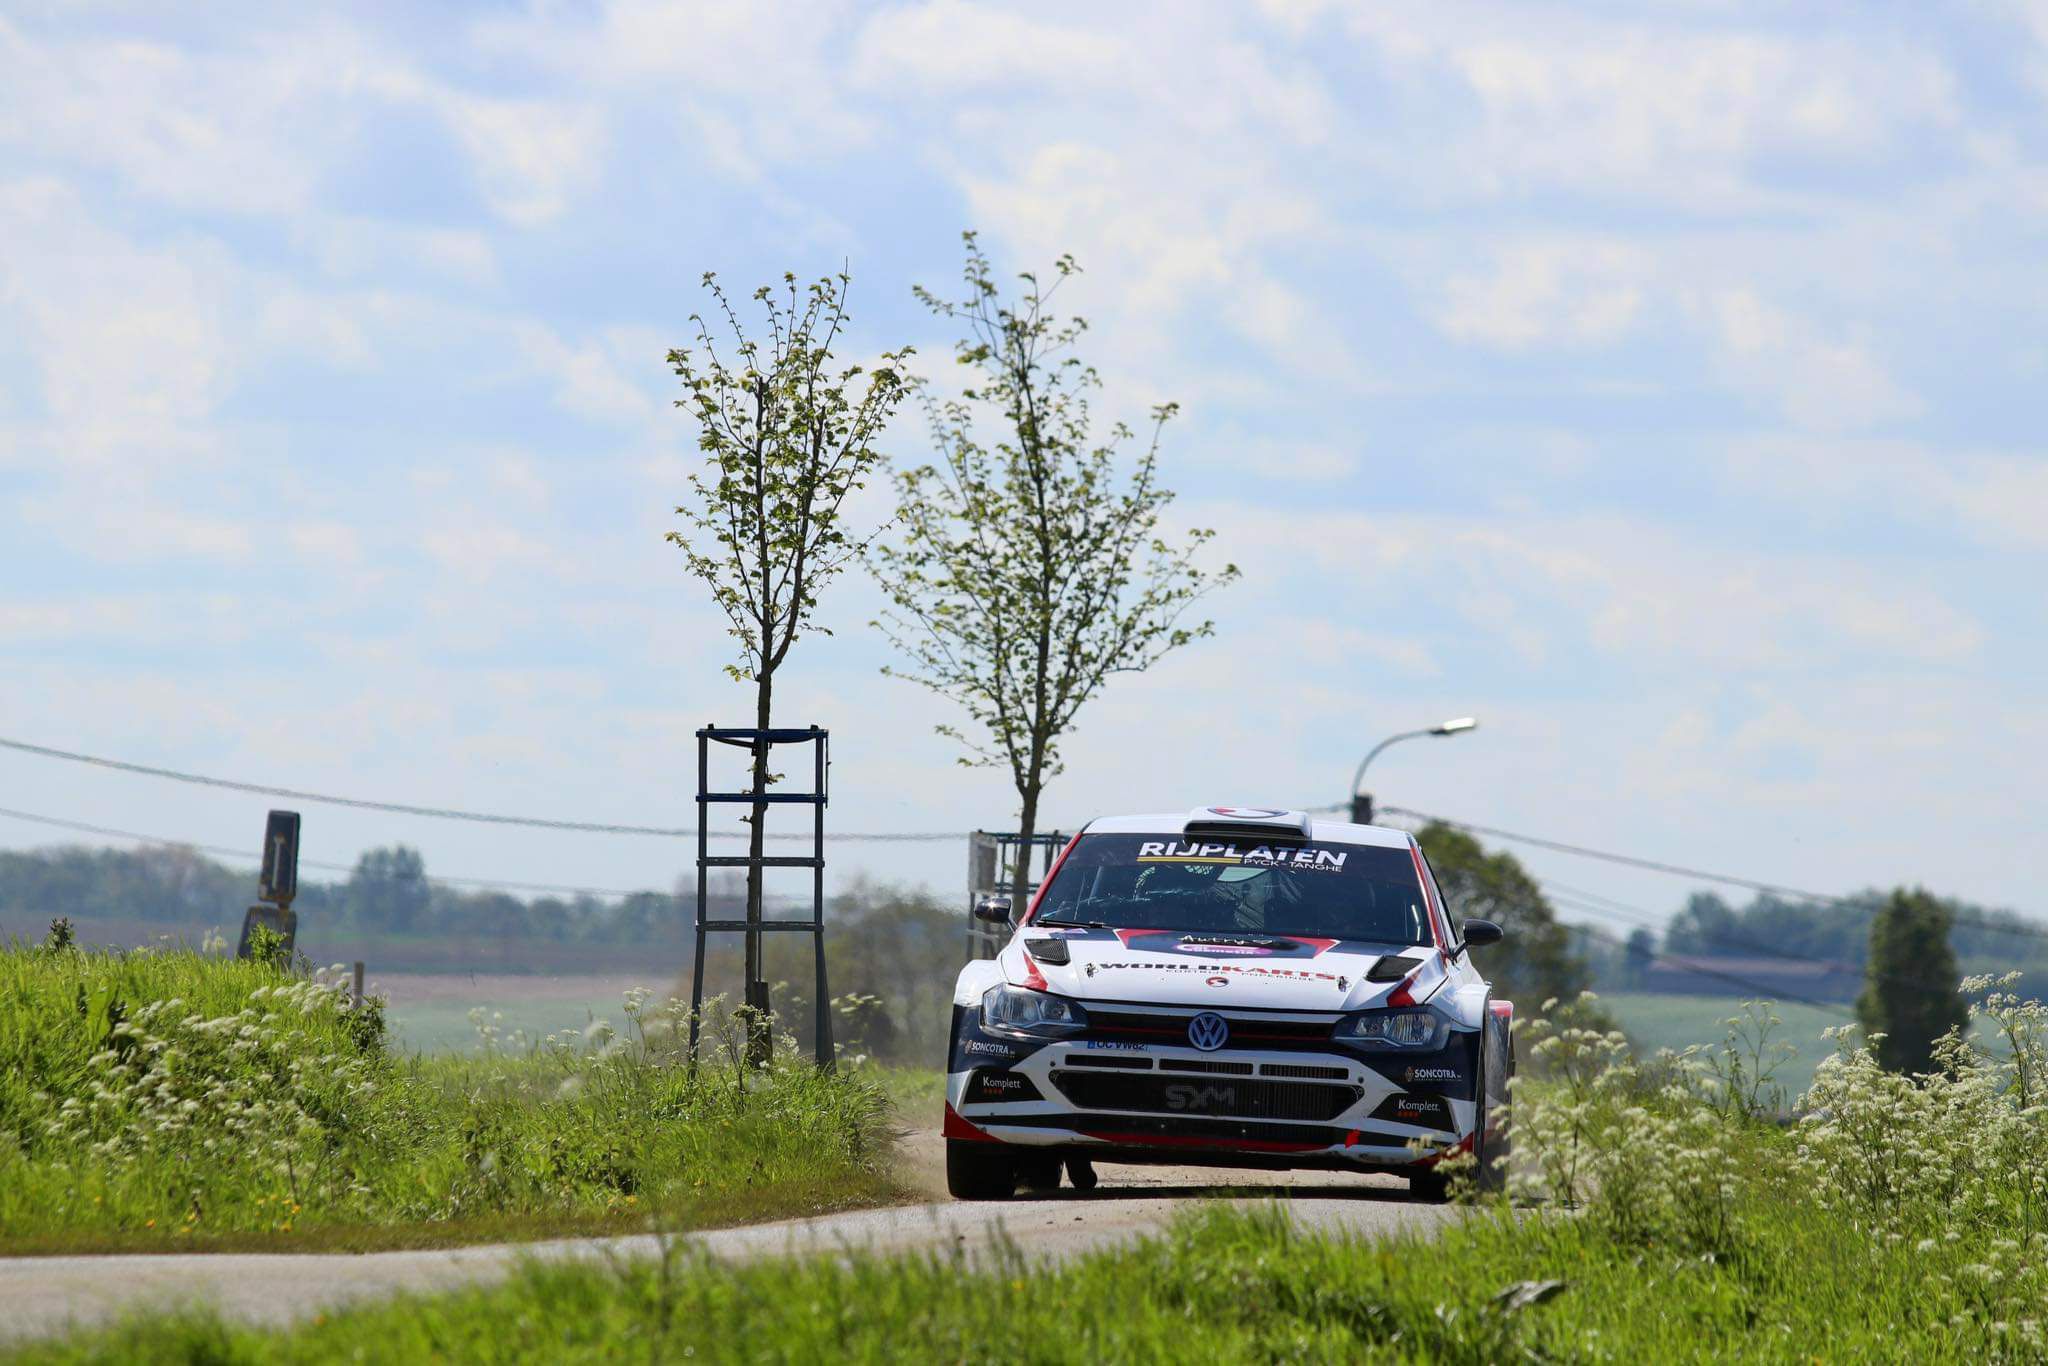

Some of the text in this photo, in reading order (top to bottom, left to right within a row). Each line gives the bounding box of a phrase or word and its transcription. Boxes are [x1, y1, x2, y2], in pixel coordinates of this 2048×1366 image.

[1139, 842, 1348, 866] RIJPLATEN
[971, 1042, 1009, 1055] SONCOTRA
[1414, 1069, 1457, 1079] SONCOTRA
[983, 1076, 1021, 1091] Komplett
